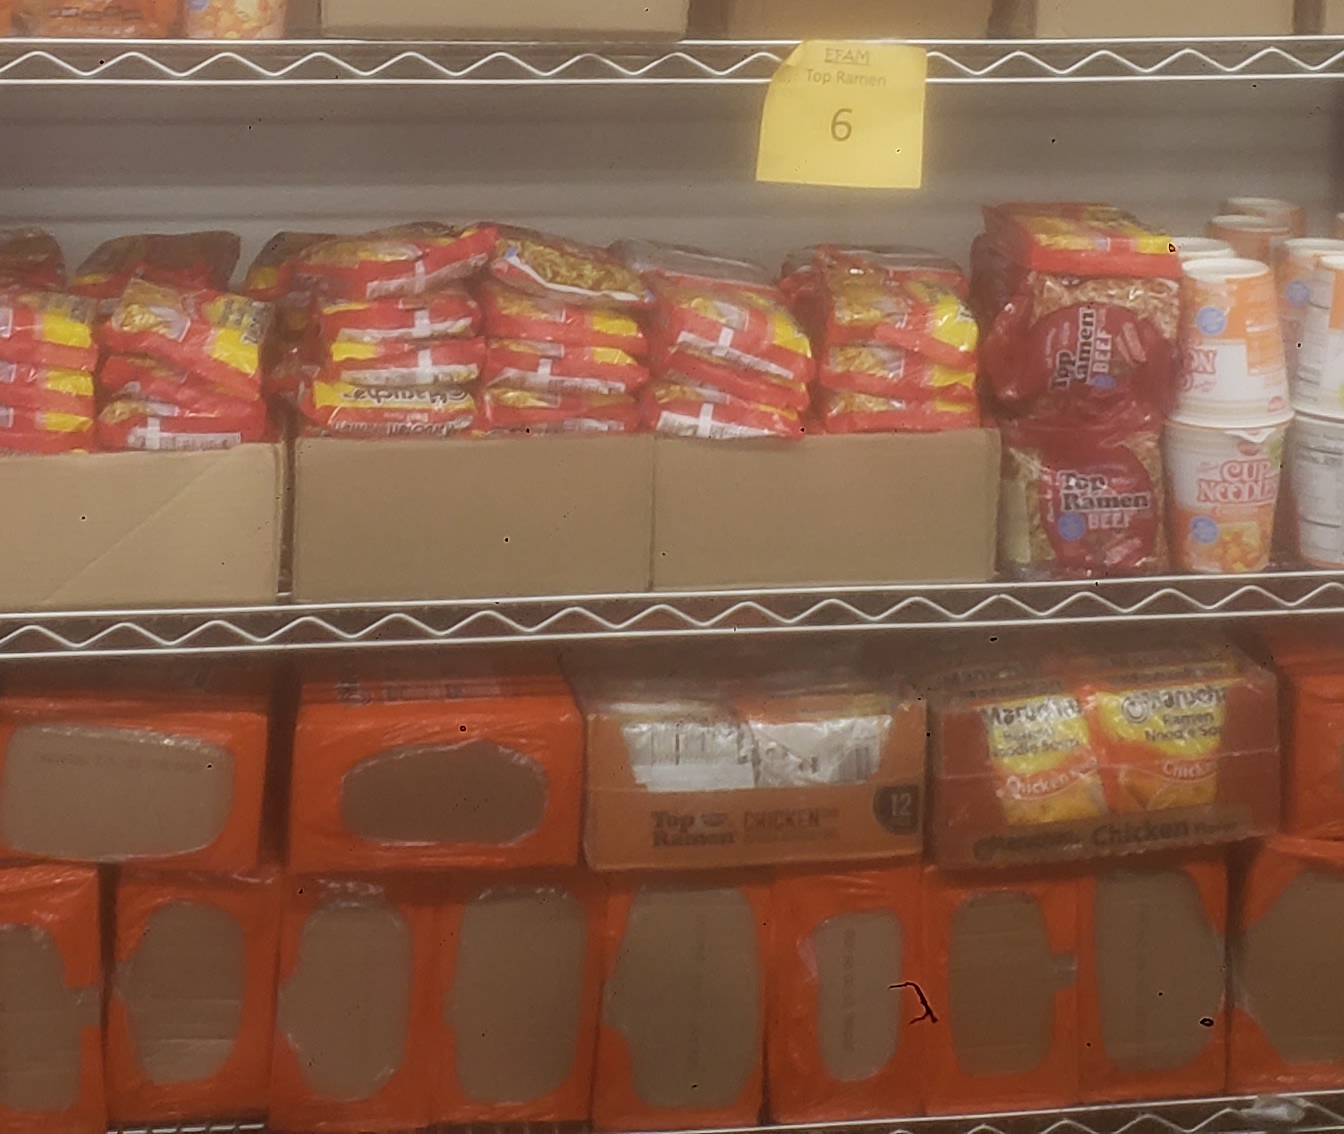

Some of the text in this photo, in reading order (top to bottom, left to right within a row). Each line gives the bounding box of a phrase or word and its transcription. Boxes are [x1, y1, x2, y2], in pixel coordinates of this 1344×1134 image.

[823, 47, 871, 65] EFAM
[805, 68, 887, 87] Top Ramen
[830, 108, 853, 142] 6
[1075, 307, 1096, 385] amen
[1092, 331, 1113, 374] BEEF
[1048, 350, 1077, 392] Top
[1058, 470, 1108, 492] Top
[1220, 458, 1273, 483] CUP
[1060, 491, 1151, 513] Ramen
[1086, 512, 1131, 531] BEEF
[1005, 770, 1068, 799] Chicken
[890, 791, 912, 817] 12
[742, 809, 821, 831] CHICKEN
[1091, 819, 1189, 847] Chicken
